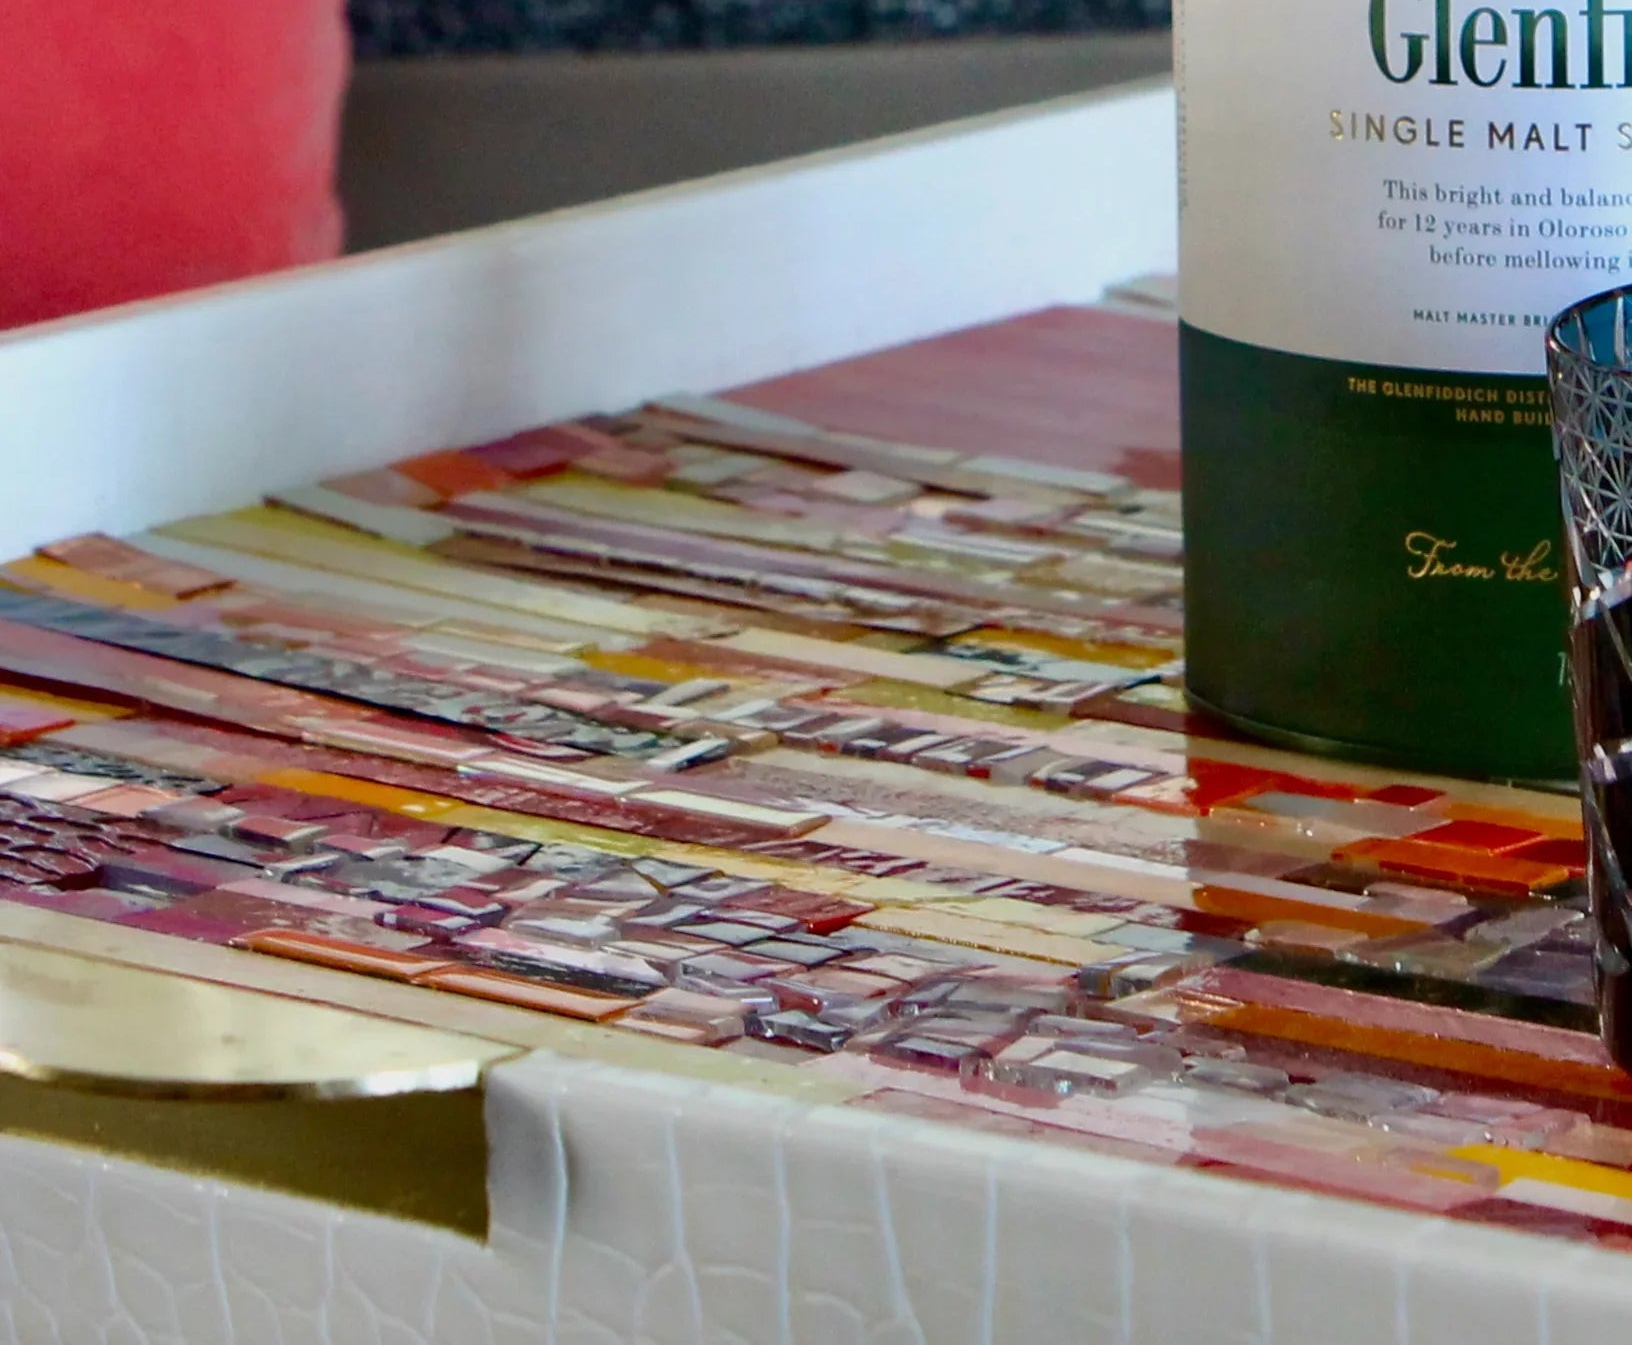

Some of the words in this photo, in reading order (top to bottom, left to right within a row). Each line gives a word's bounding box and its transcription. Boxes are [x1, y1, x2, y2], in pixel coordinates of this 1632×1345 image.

[1330, 109, 1465, 148] SINGLE
[1488, 121, 1592, 152] MALT
[1383, 179, 1428, 201] This
[1435, 183, 1501, 209] bright
[1511, 188, 1551, 207] and
[1378, 211, 1406, 231] for
[1415, 213, 1436, 232] 12
[1443, 219, 1501, 239] years
[1510, 219, 1530, 237] in
[1539, 219, 1627, 238] Oloroso
[1429, 245, 1496, 268] before
[1505, 251, 1620, 274] mellowing
[1413, 310, 1449, 323] MALT
[1457, 313, 1515, 326] MASTER
[1523, 314, 1549, 327] BRI
[1347, 378, 1376, 395] THE
[1382, 381, 1498, 403] GLENFIDDICH
[1456, 408, 1504, 425] HAND
[1513, 410, 1552, 426] BUIL
[1405, 532, 1496, 580] From
[1500, 539, 1559, 582] the
